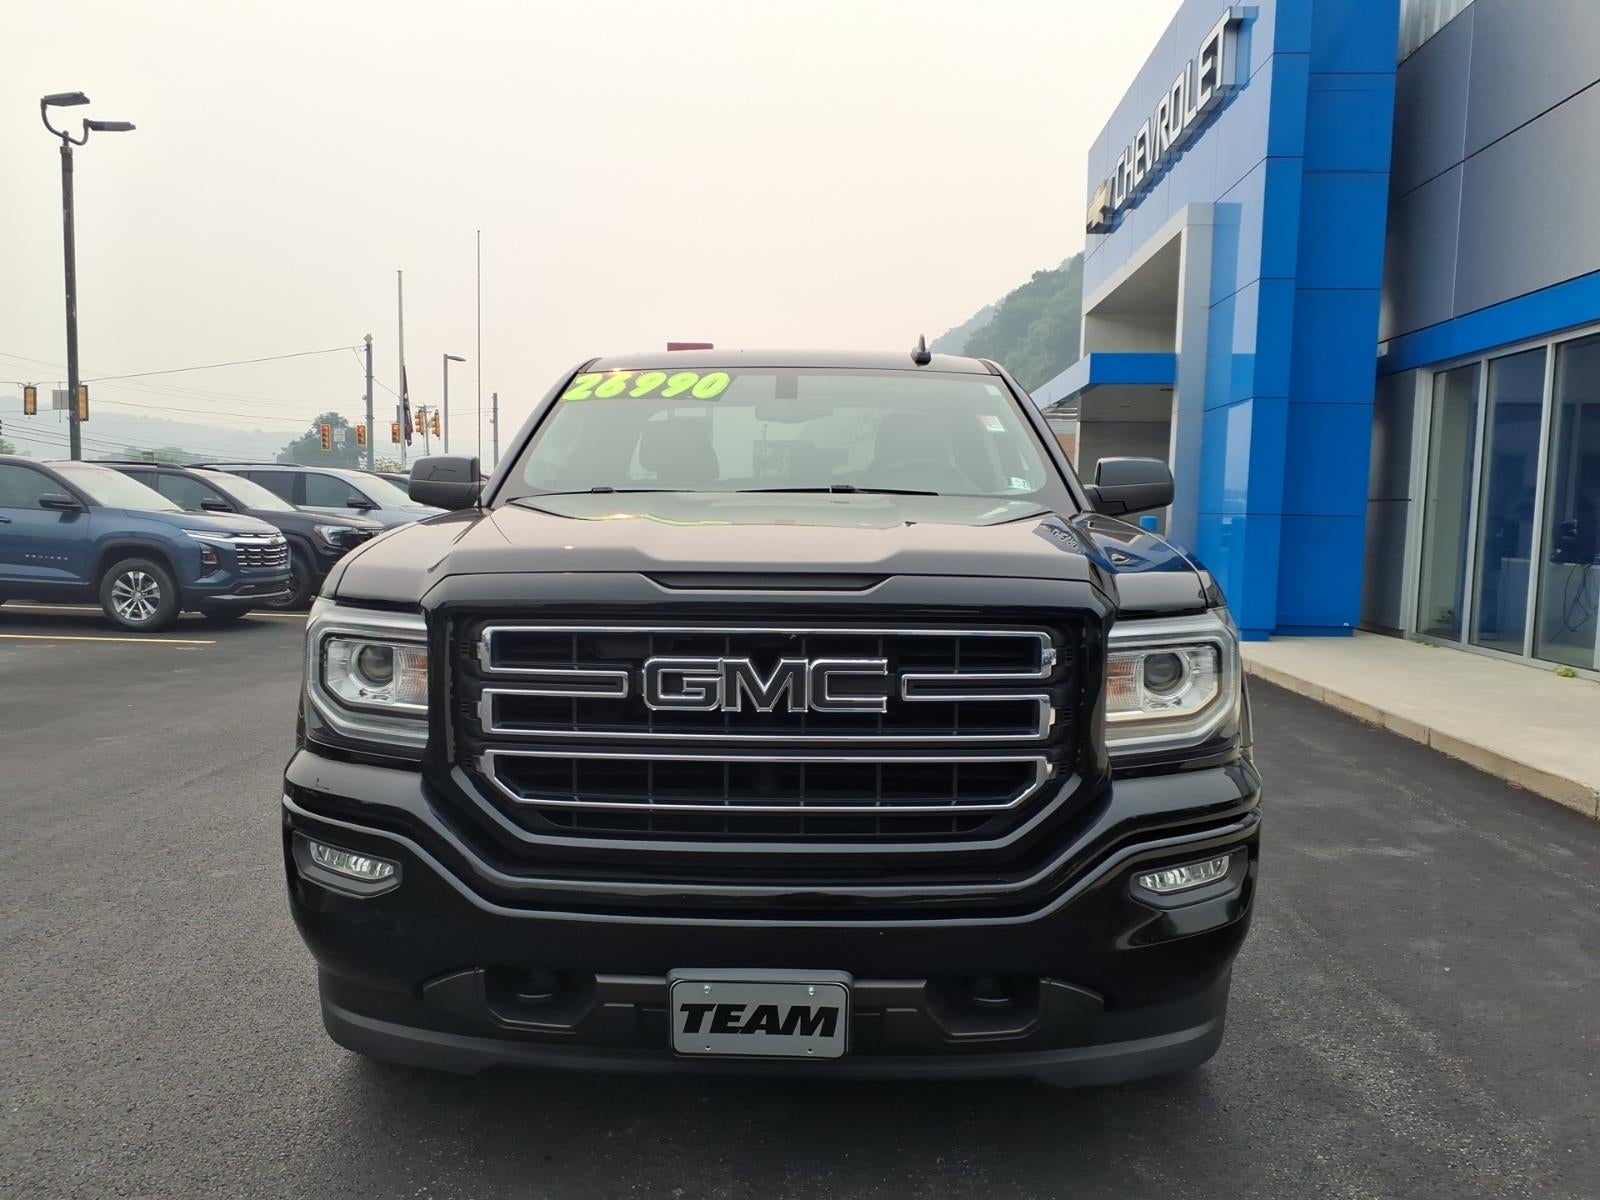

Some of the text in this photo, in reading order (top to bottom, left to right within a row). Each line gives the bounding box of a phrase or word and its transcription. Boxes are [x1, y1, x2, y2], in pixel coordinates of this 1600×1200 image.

[1114, 7, 1234, 210] CHEVROLET
[562, 371, 731, 401] 26990
[642, 656, 889, 714] GMC
[680, 1003, 839, 1038] TEAM
